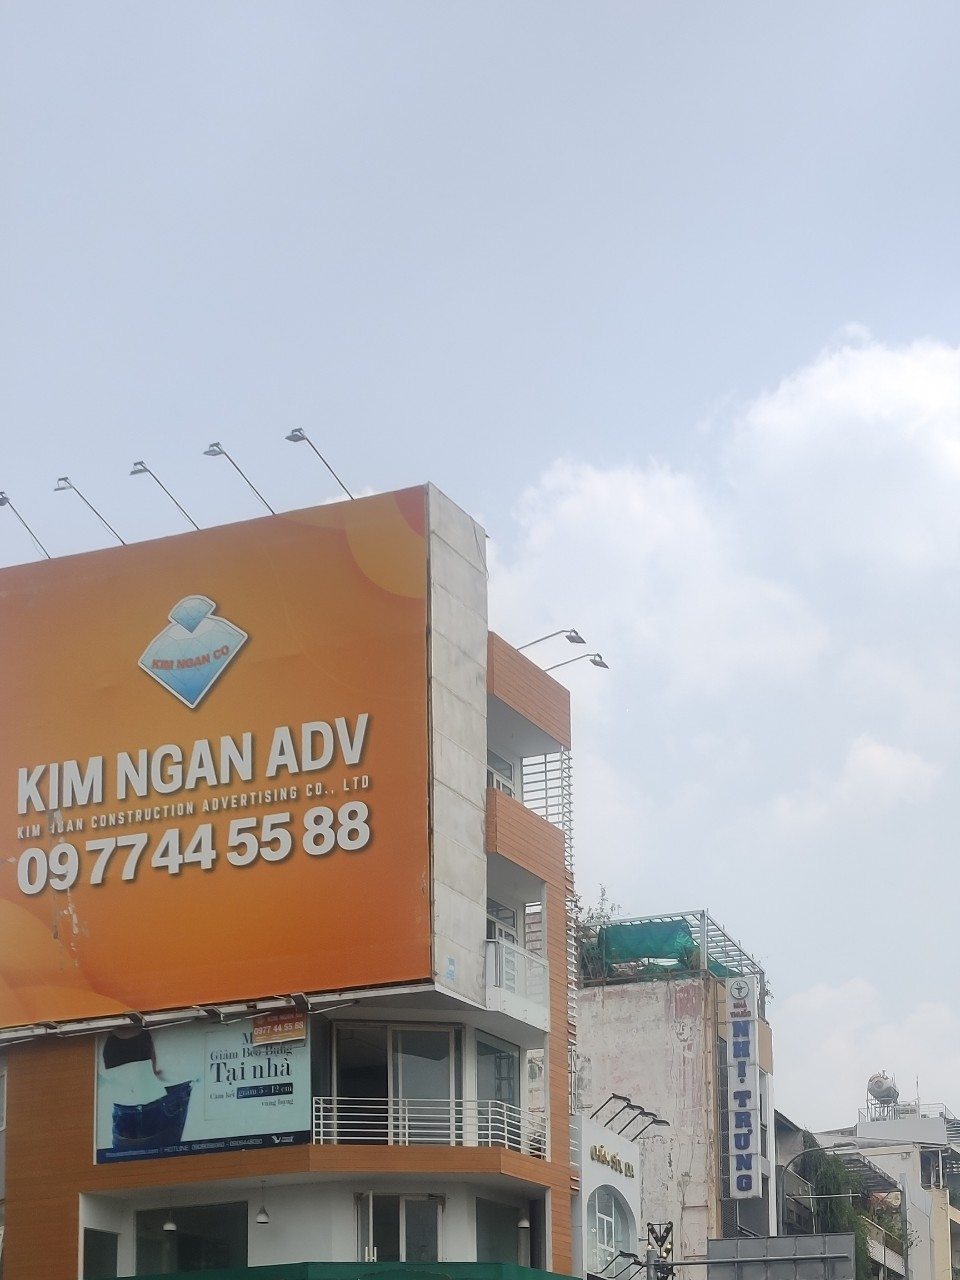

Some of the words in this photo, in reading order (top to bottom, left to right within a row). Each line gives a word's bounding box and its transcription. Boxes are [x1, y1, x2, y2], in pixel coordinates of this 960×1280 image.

[152, 658, 174, 670] KIM
[177, 653, 211, 669] NGAN
[213, 645, 229, 660] CO
[17, 755, 103, 815] KIM
[116, 731, 252, 800] NGAN
[265, 712, 369, 778] ADV
[17, 824, 41, 840] KIM
[90, 801, 195, 829] CONSTRUCTION
[201, 786, 298, 813] ADVERTISING
[343, 774, 370, 792] LTD
[210, 1061, 249, 1086] Tại
[251, 1057, 293, 1079] nhà
